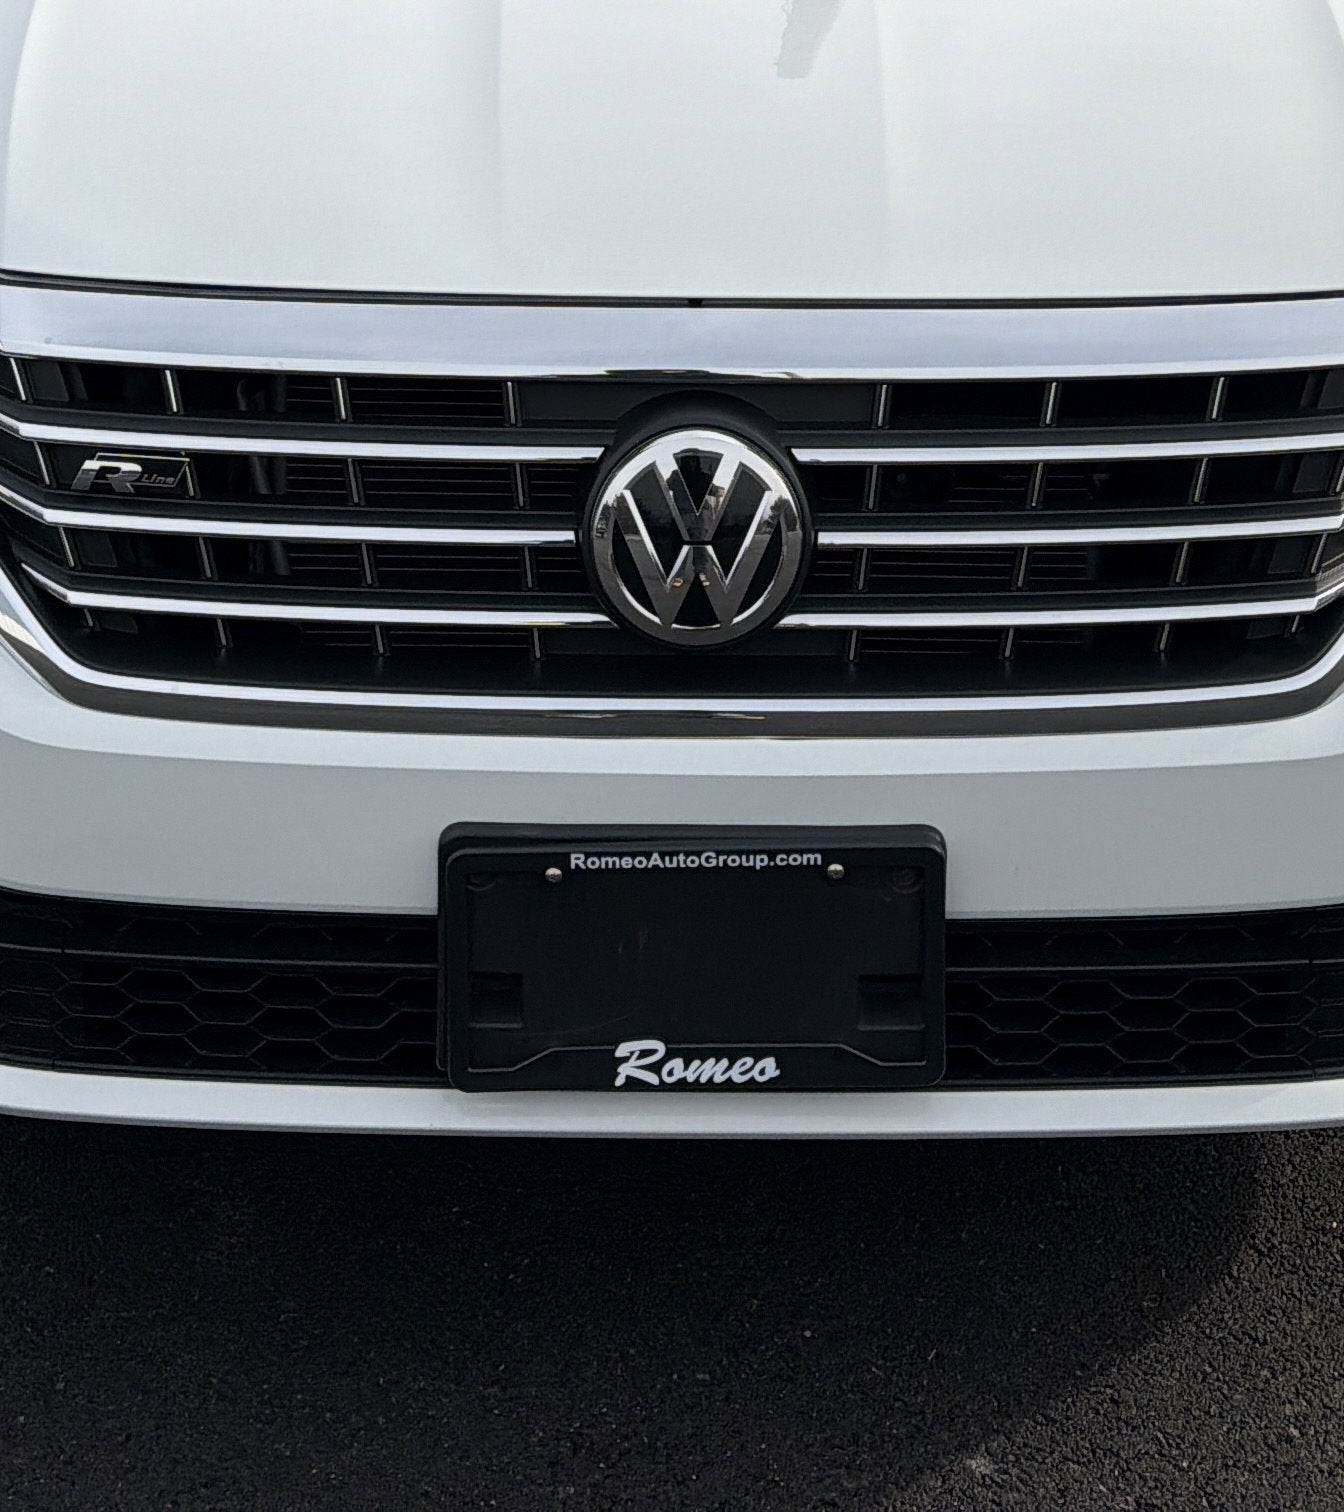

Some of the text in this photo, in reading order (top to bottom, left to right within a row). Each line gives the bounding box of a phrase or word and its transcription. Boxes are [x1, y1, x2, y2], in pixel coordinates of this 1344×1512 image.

[71, 460, 143, 494] R
[570, 851, 822, 870] RomeoAutoGroup.com
[614, 1039, 781, 1088] Romeo
